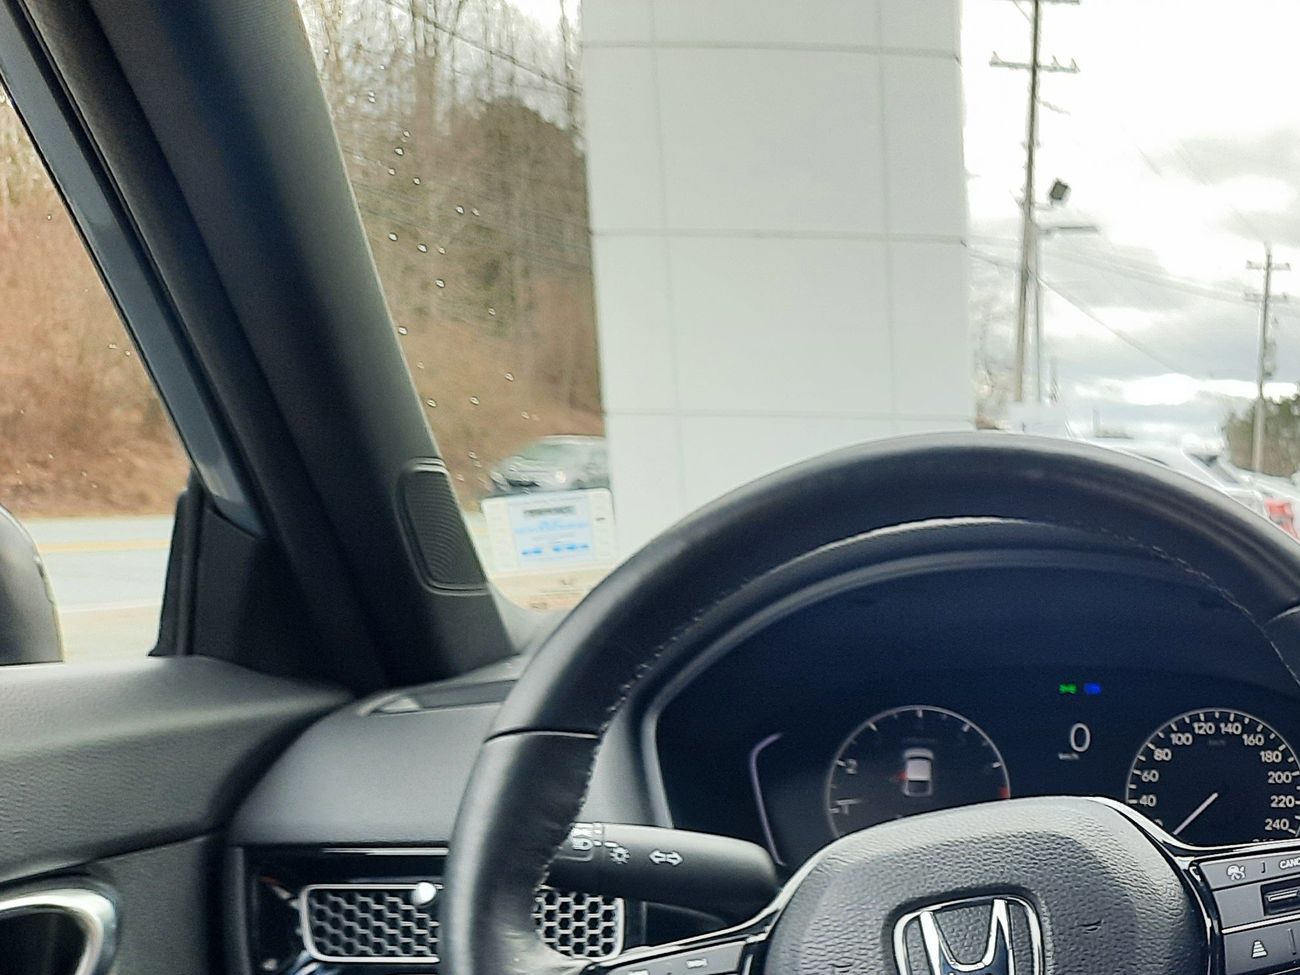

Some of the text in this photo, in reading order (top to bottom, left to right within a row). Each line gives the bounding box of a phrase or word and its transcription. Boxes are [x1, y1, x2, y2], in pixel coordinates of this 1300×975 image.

[1193, 722, 1215, 735] 120
[1220, 722, 1242, 735] 140
[1070, 723, 1091, 752] 0
[1170, 733, 1192, 746] 100
[1243, 734, 1264, 747] 160
[1154, 749, 1172, 761] 80
[1260, 750, 1282, 763] 180
[1141, 770, 1159, 782] 60
[1268, 772, 1292, 784] 200
[1139, 795, 1157, 807] 40
[1271, 795, 1295, 808] 220
[1265, 819, 1289, 832] 240
